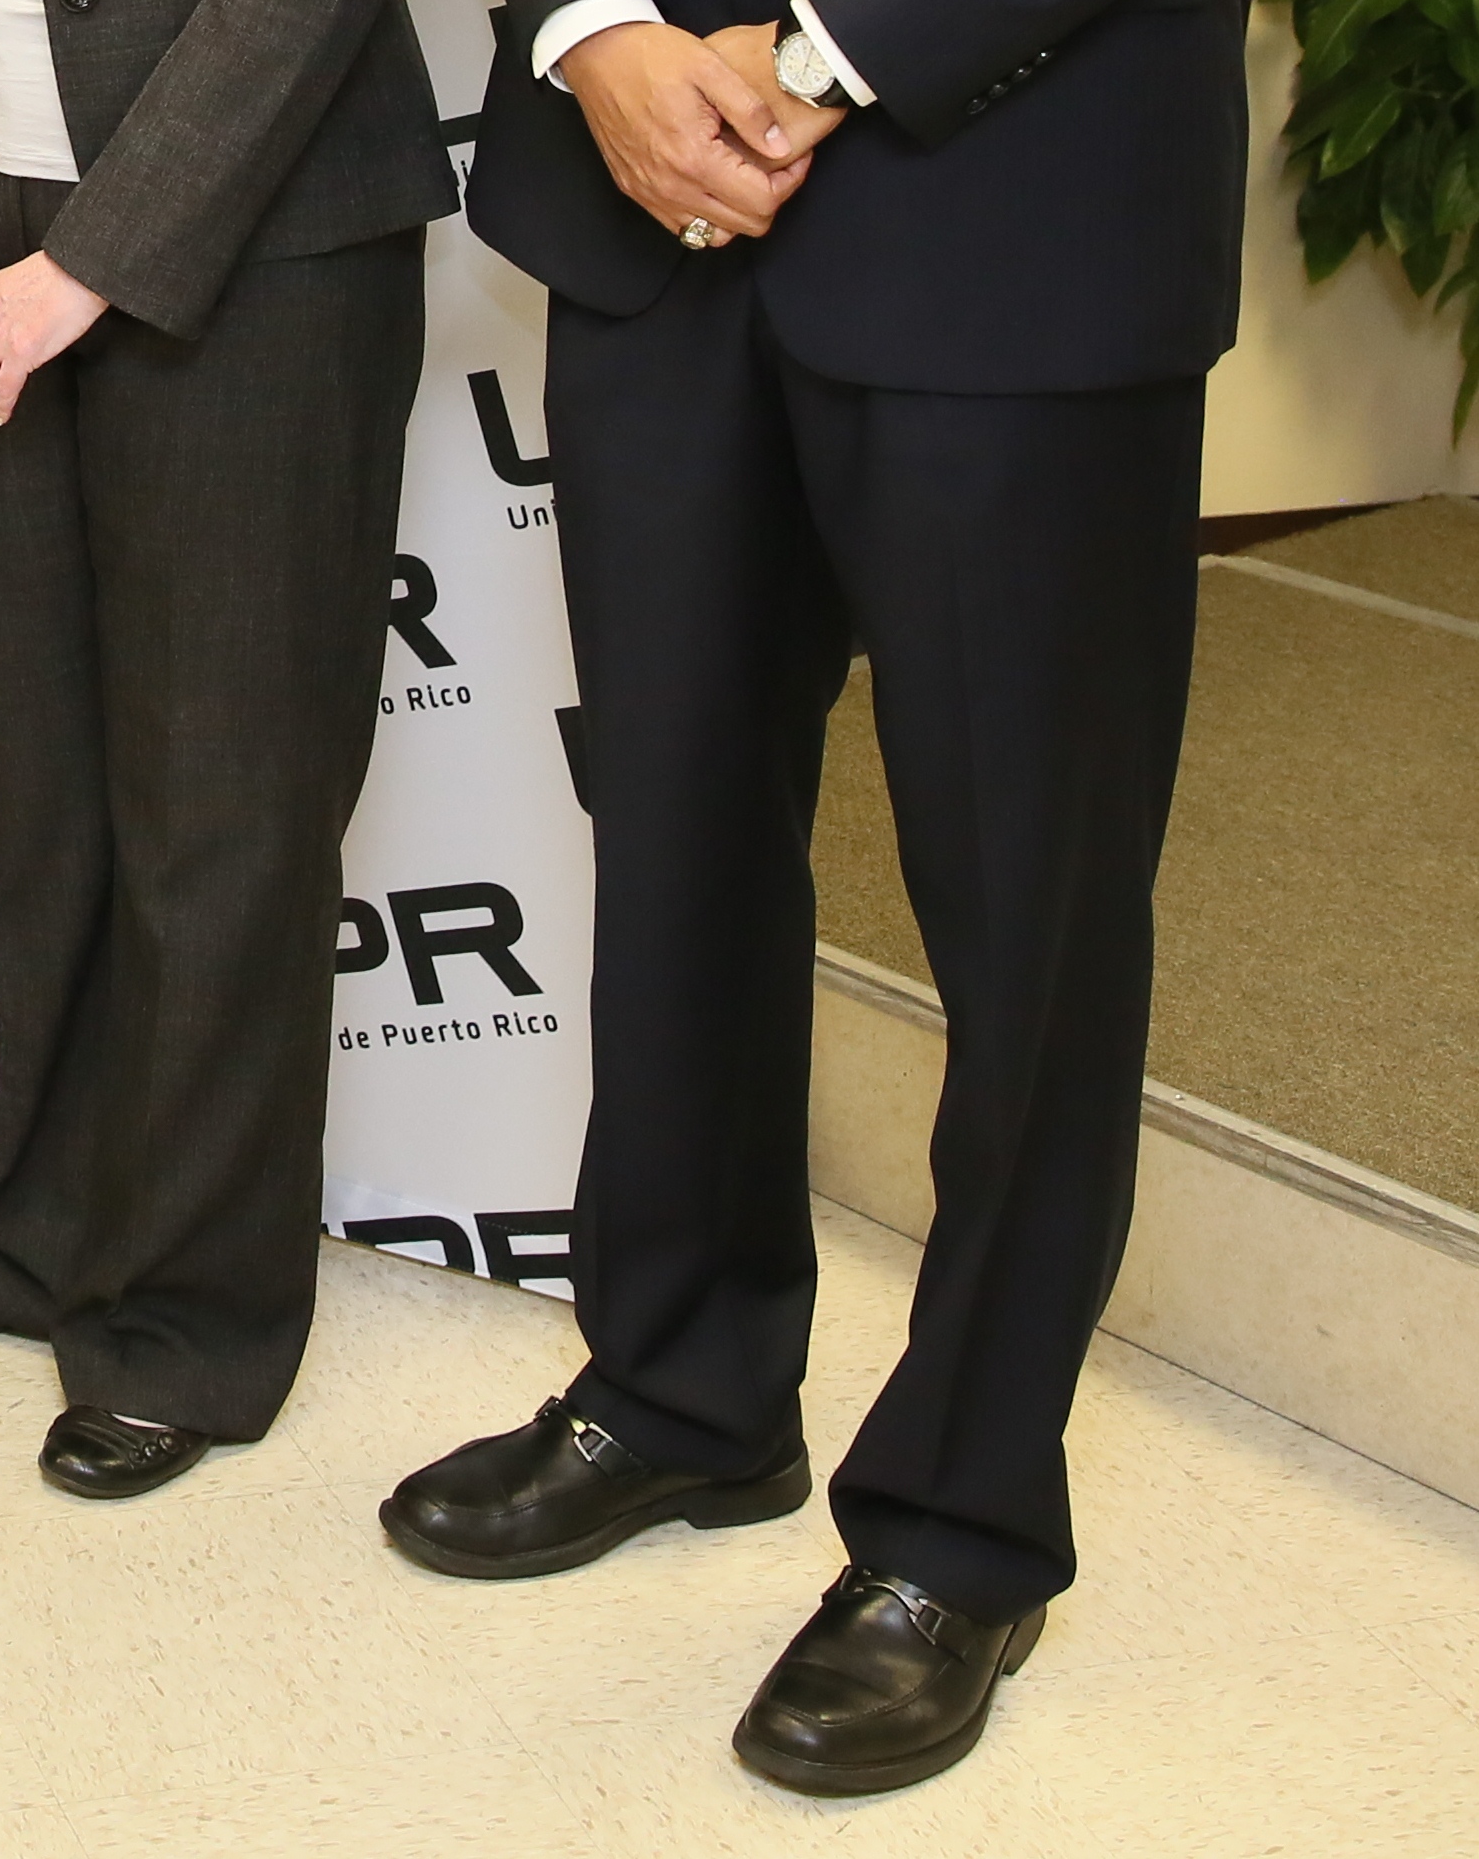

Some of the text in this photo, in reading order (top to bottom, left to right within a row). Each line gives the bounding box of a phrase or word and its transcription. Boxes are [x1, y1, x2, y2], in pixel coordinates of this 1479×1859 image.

[406, 684, 472, 711] Rico
[339, 1012, 558, 1050] de Puerto Rico
